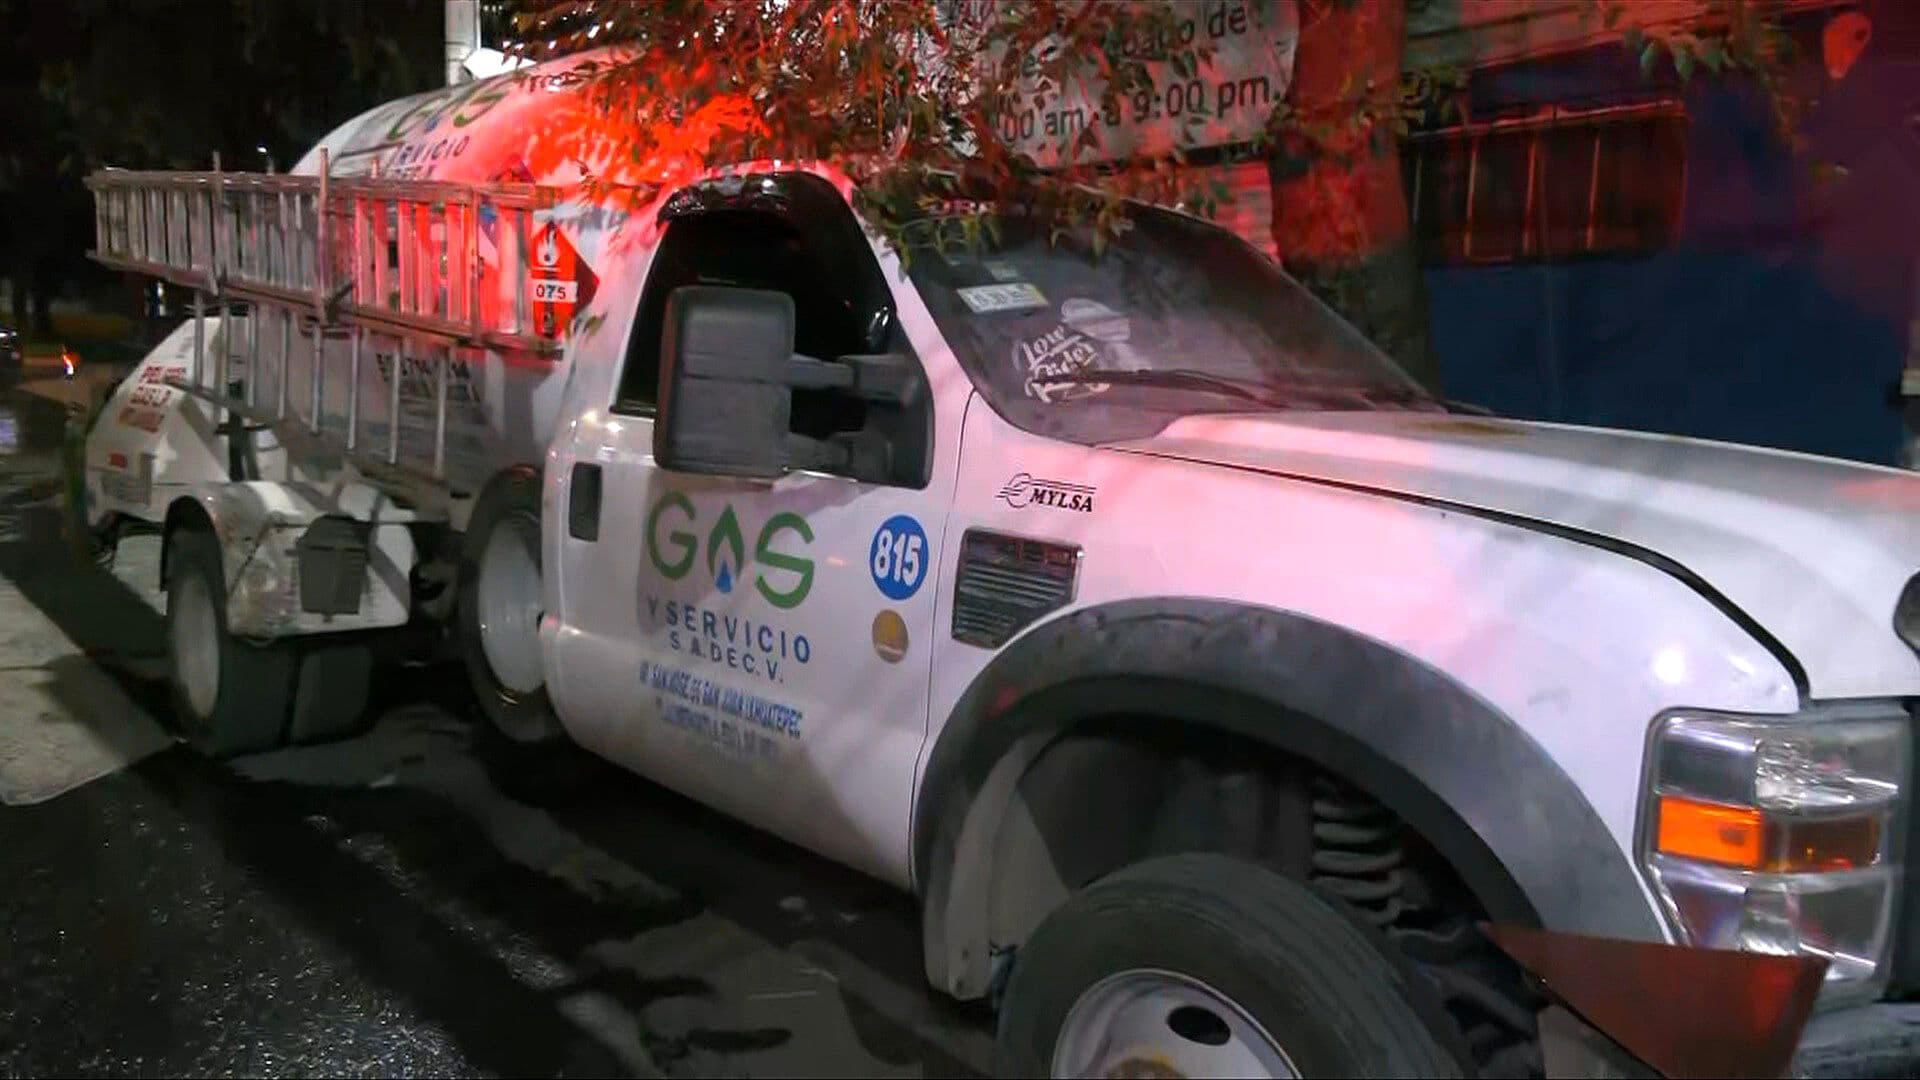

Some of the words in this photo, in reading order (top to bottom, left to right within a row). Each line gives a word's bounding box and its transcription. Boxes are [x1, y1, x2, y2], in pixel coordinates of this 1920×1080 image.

[1207, 2, 1247, 38] de
[1133, 79, 1205, 123] 9:00
[535, 283, 567, 300] 075
[1029, 488, 1093, 513] MYLSA
[647, 489, 815, 609] GAS
[874, 529, 922, 587] 815
[665, 600, 810, 664] SERVICIO
